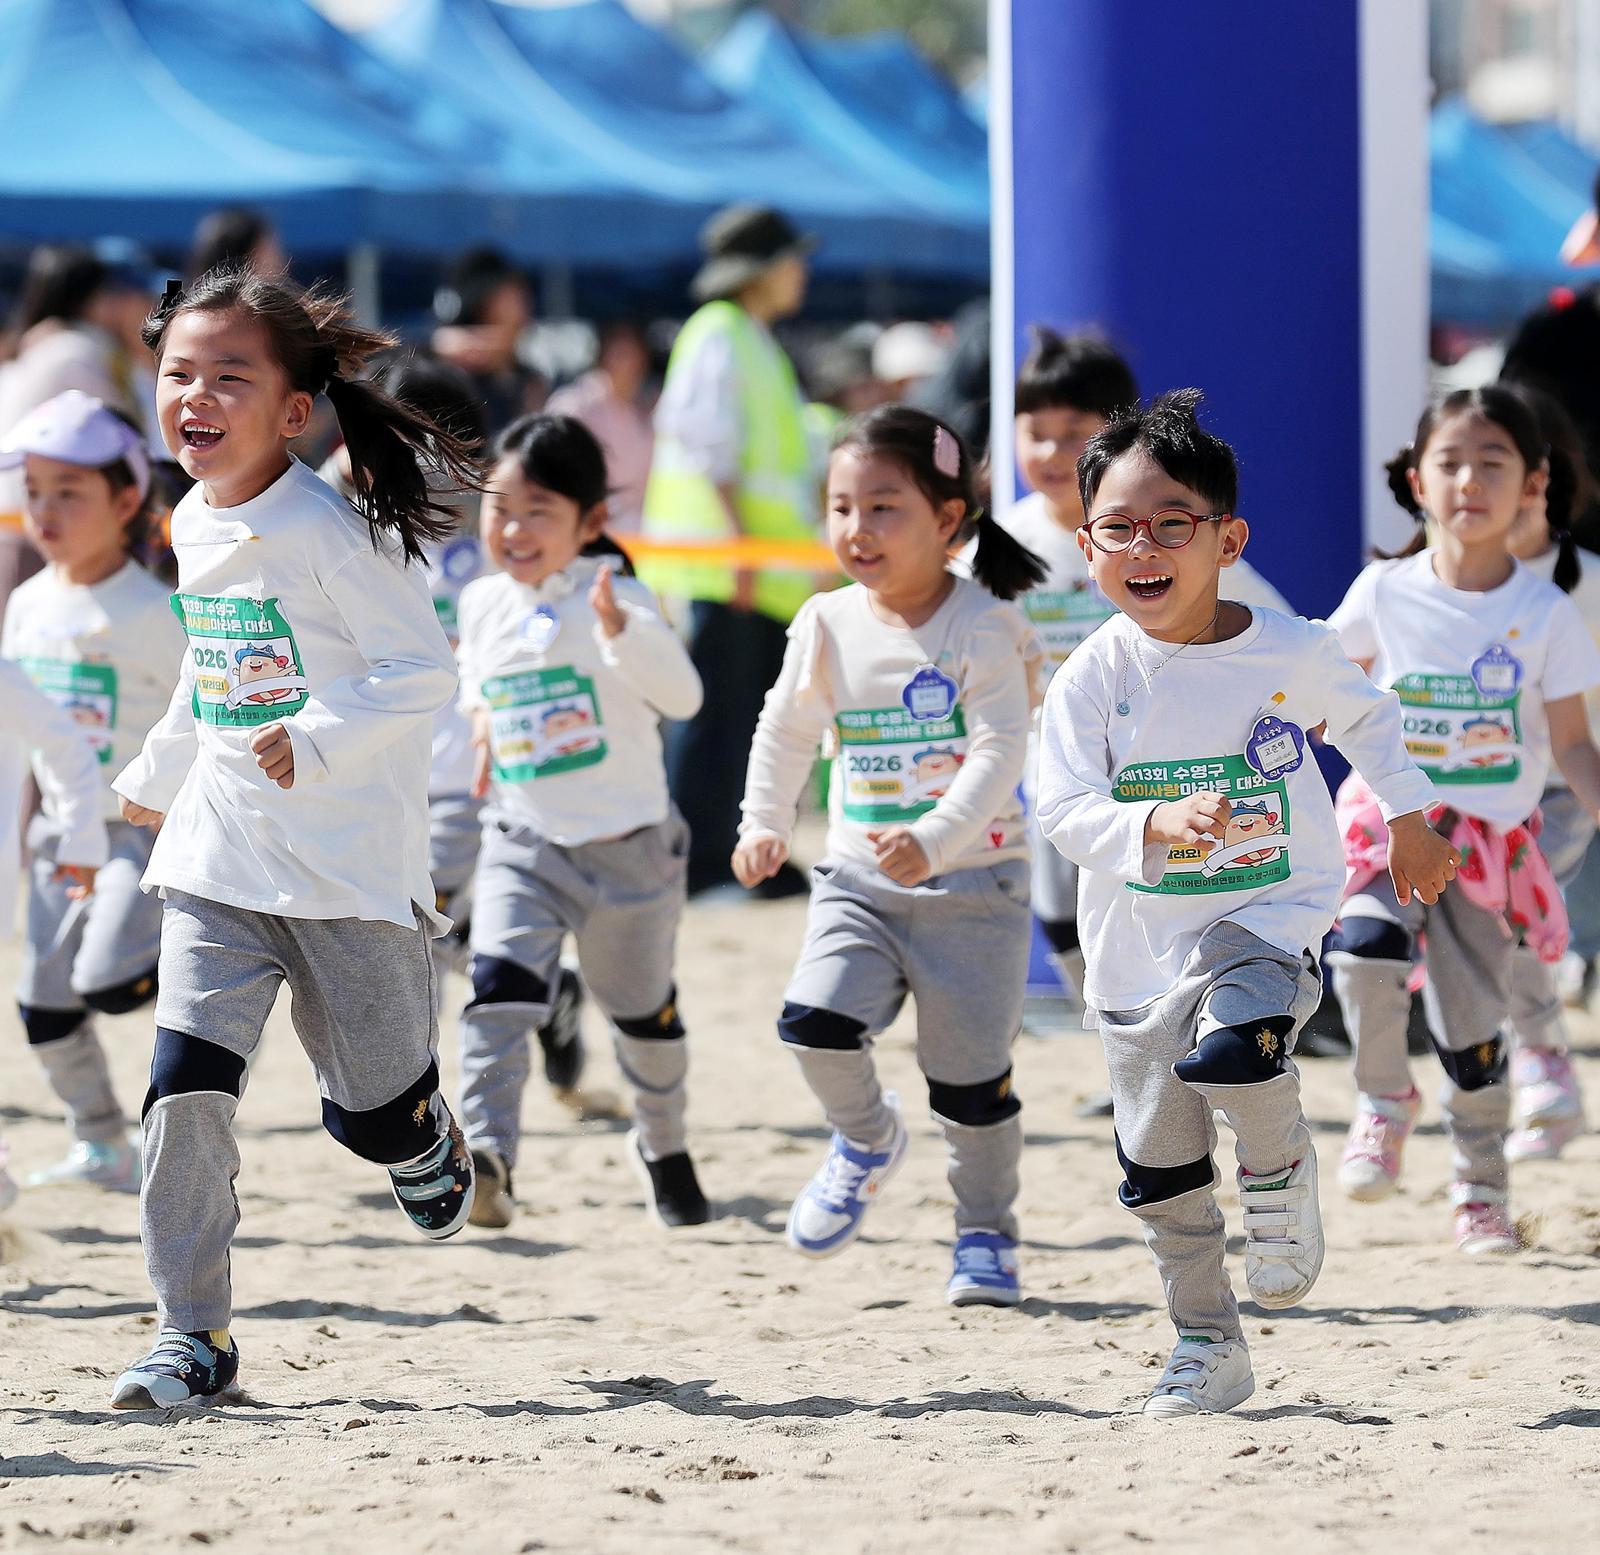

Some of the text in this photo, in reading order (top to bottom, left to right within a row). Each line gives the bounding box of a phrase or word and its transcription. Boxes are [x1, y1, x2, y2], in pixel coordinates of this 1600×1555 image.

[206, 602, 237, 617] 수영구
[193, 647, 228, 670] 026
[1403, 717, 1452, 736] 026
[848, 755, 903, 772] 2026
[1119, 763, 1225, 783] 제13회 수영구
[1119, 774, 1268, 798] 아이사랑마라톤 대회
